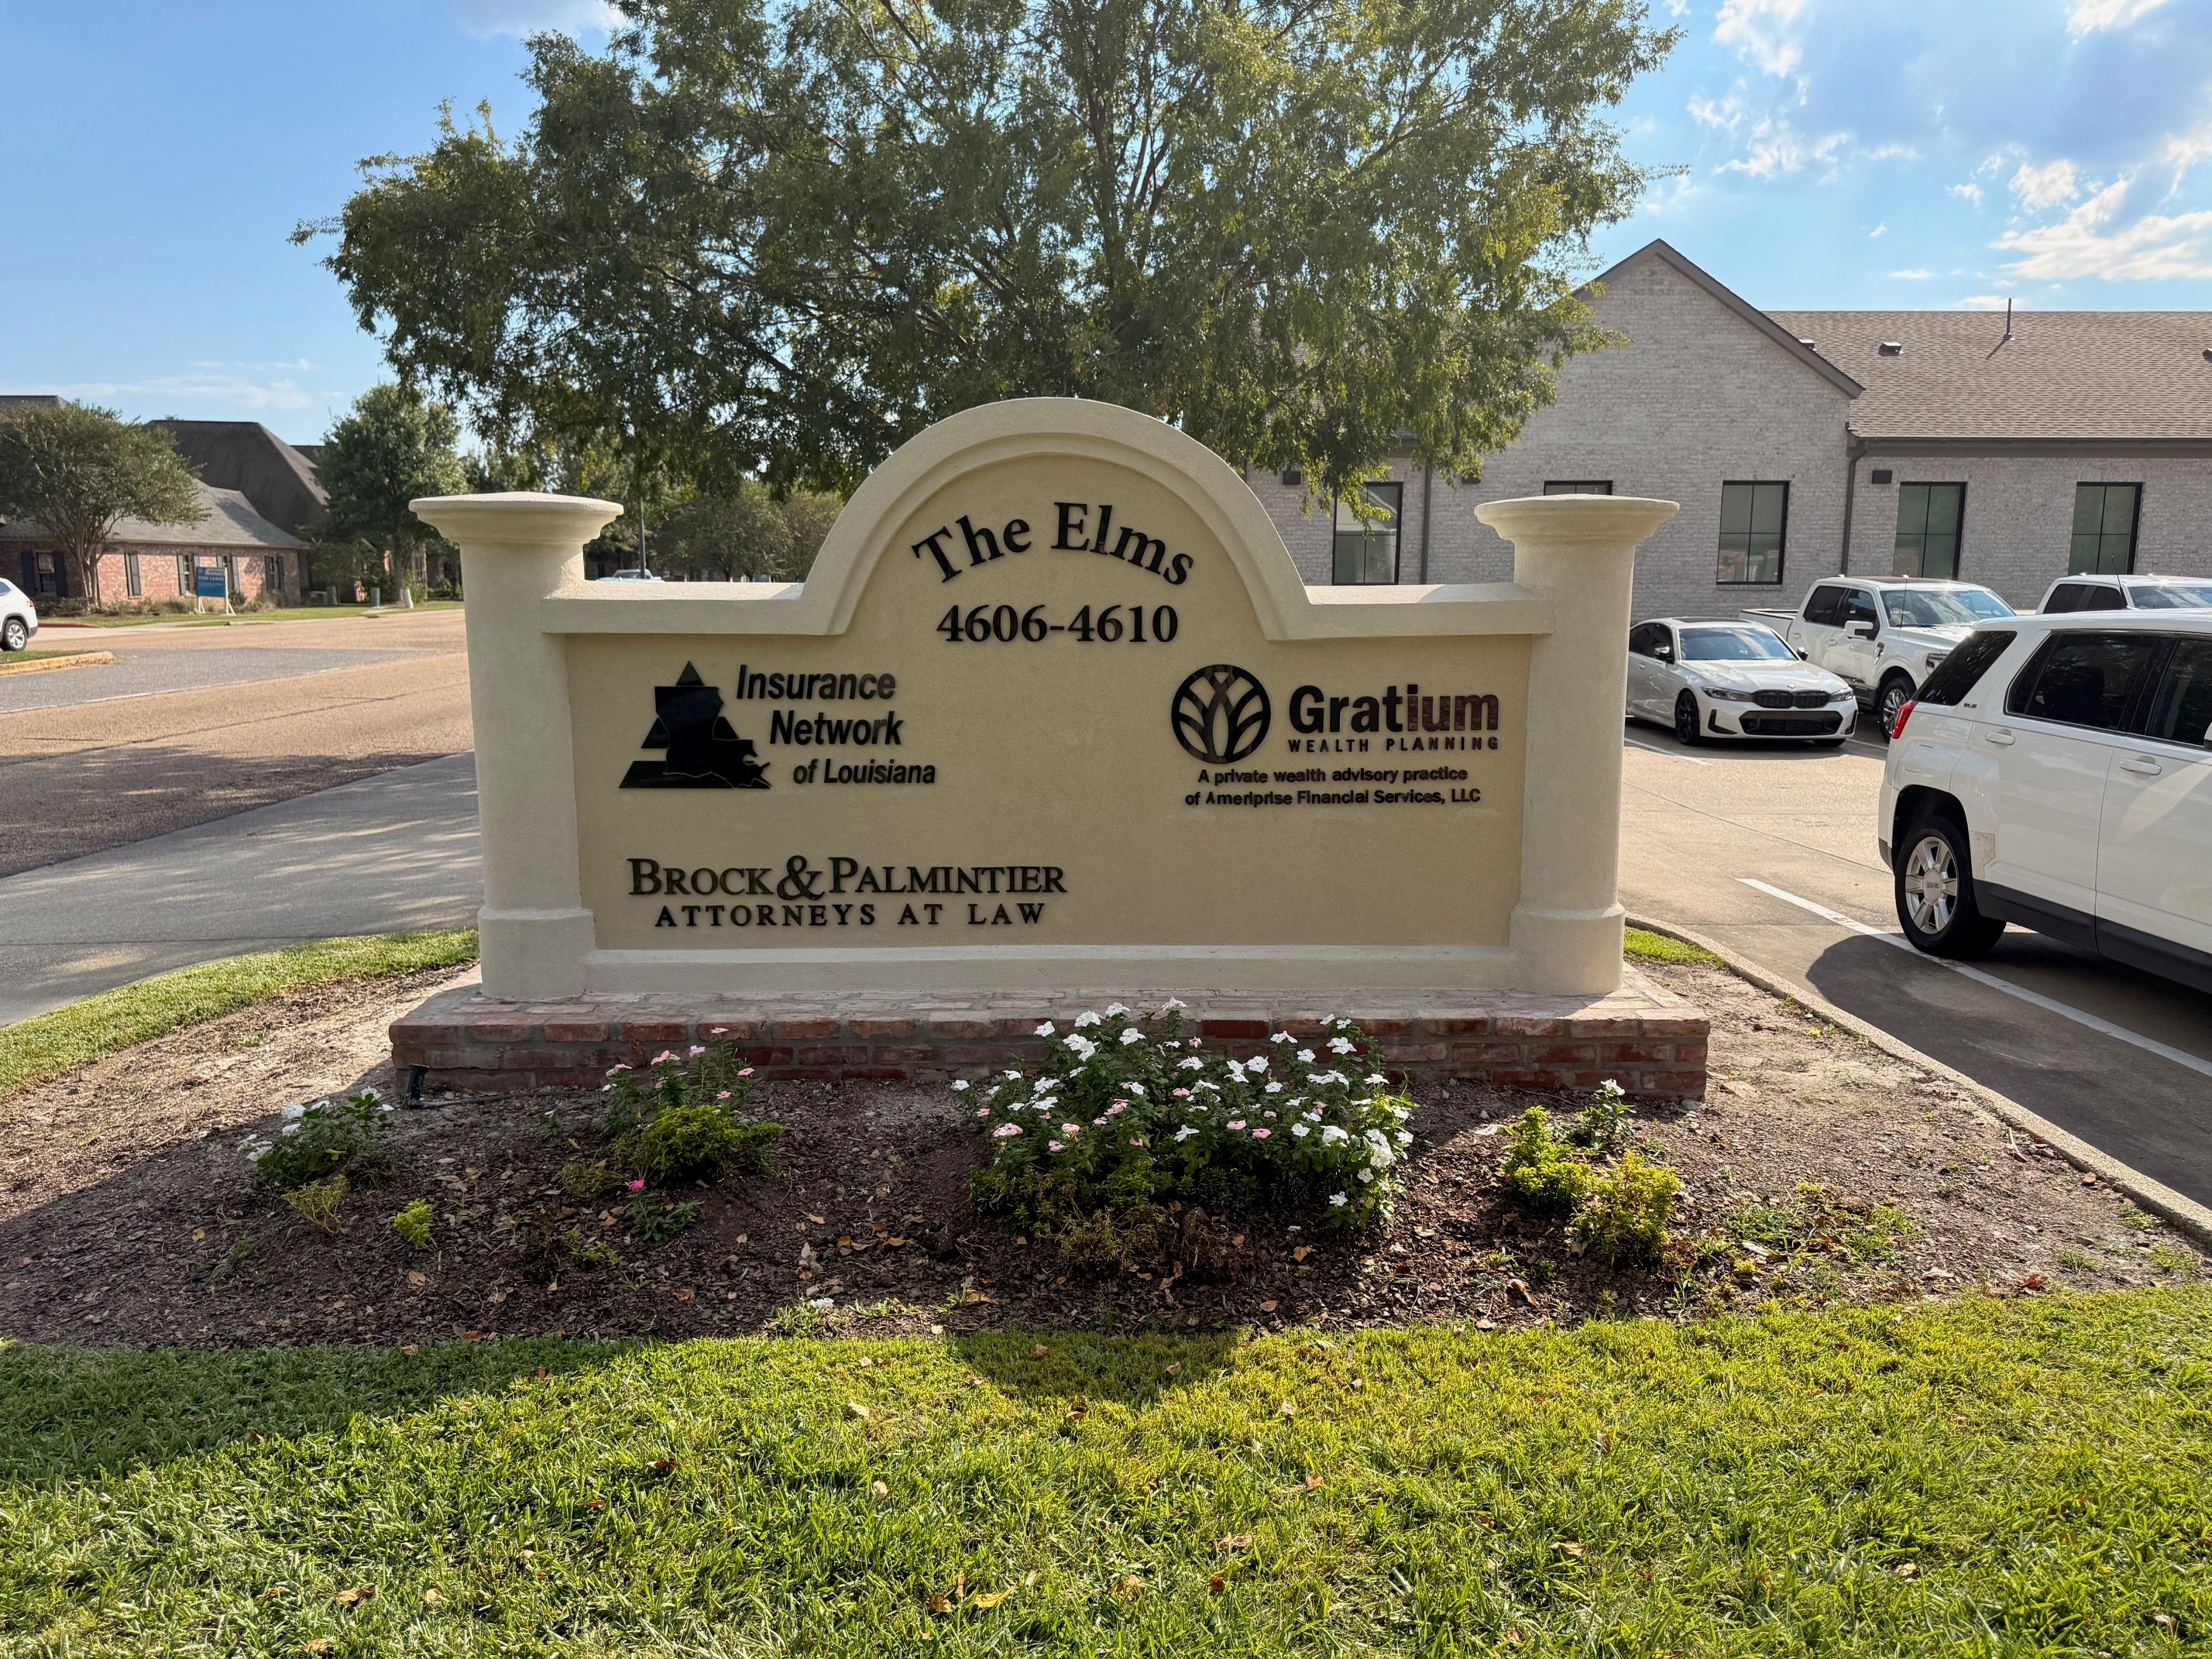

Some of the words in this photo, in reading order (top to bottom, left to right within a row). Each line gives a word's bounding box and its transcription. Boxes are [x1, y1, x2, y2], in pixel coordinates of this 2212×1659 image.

[912, 515, 1032, 583] The
[1051, 502, 1194, 585] Elms
[936, 605, 1178, 642] 4606-4610
[737, 665, 895, 700] Insurance
[1289, 684, 1499, 733] Gratium
[770, 710, 904, 745] Network
[1288, 739, 1368, 752] WEALTH
[1386, 737, 1498, 751] PLANNING
[793, 759, 818, 785] of
[824, 758, 936, 784] Louisiana
[1198, 769, 1210, 783] A
[1214, 769, 1268, 786] private
[1273, 768, 1326, 782] wealth
[1332, 768, 1399, 784] advisory
[1403, 766, 1468, 784] practice
[1185, 792, 1200, 805] of
[1206, 792, 1293, 808] Ameriprise
[1297, 790, 1369, 804] Financial
[1374, 789, 1445, 805] Services,
[1451, 788, 1480, 802] LLC
[655, 903, 874, 927] ATTORNEYS
[898, 904, 943, 925] AT
[968, 903, 1045, 925] LAW
